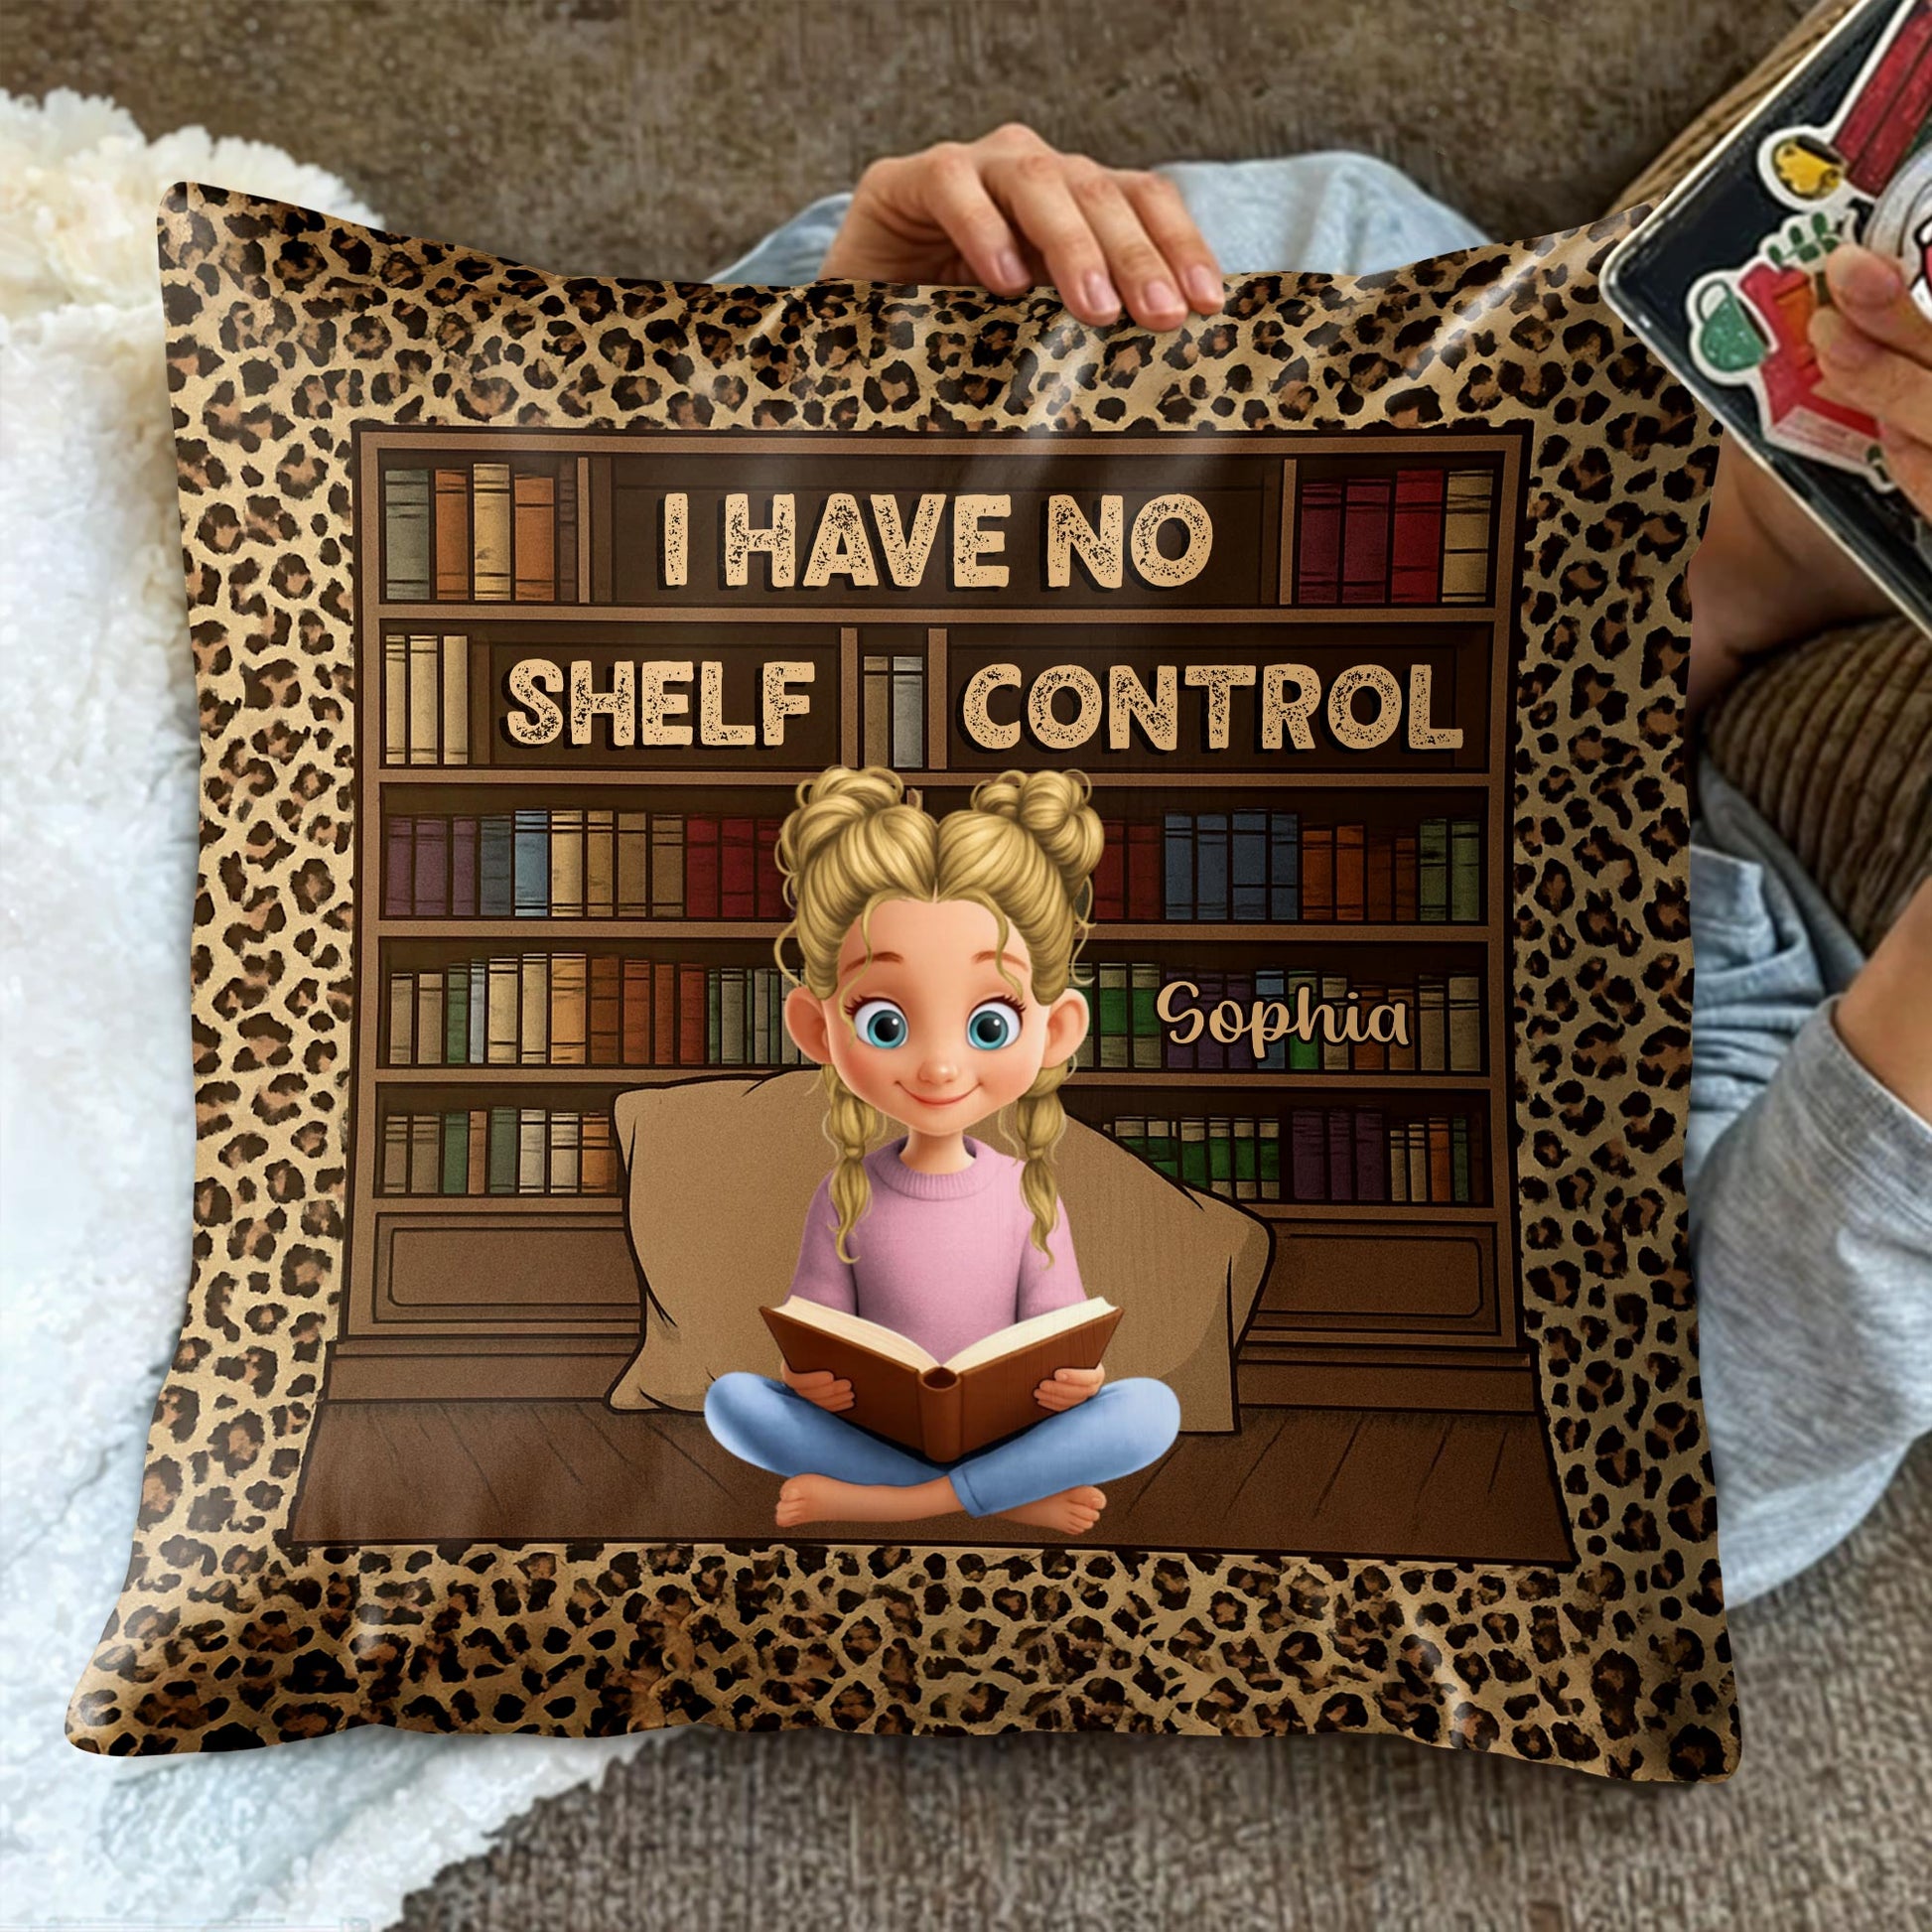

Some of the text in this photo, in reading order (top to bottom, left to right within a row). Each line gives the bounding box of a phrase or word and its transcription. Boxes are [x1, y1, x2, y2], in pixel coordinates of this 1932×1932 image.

[664, 492, 1214, 589] I HAVE NO
[507, 659, 1463, 752] SHELF CONTROL
[1156, 980, 1410, 1059] Sophia
